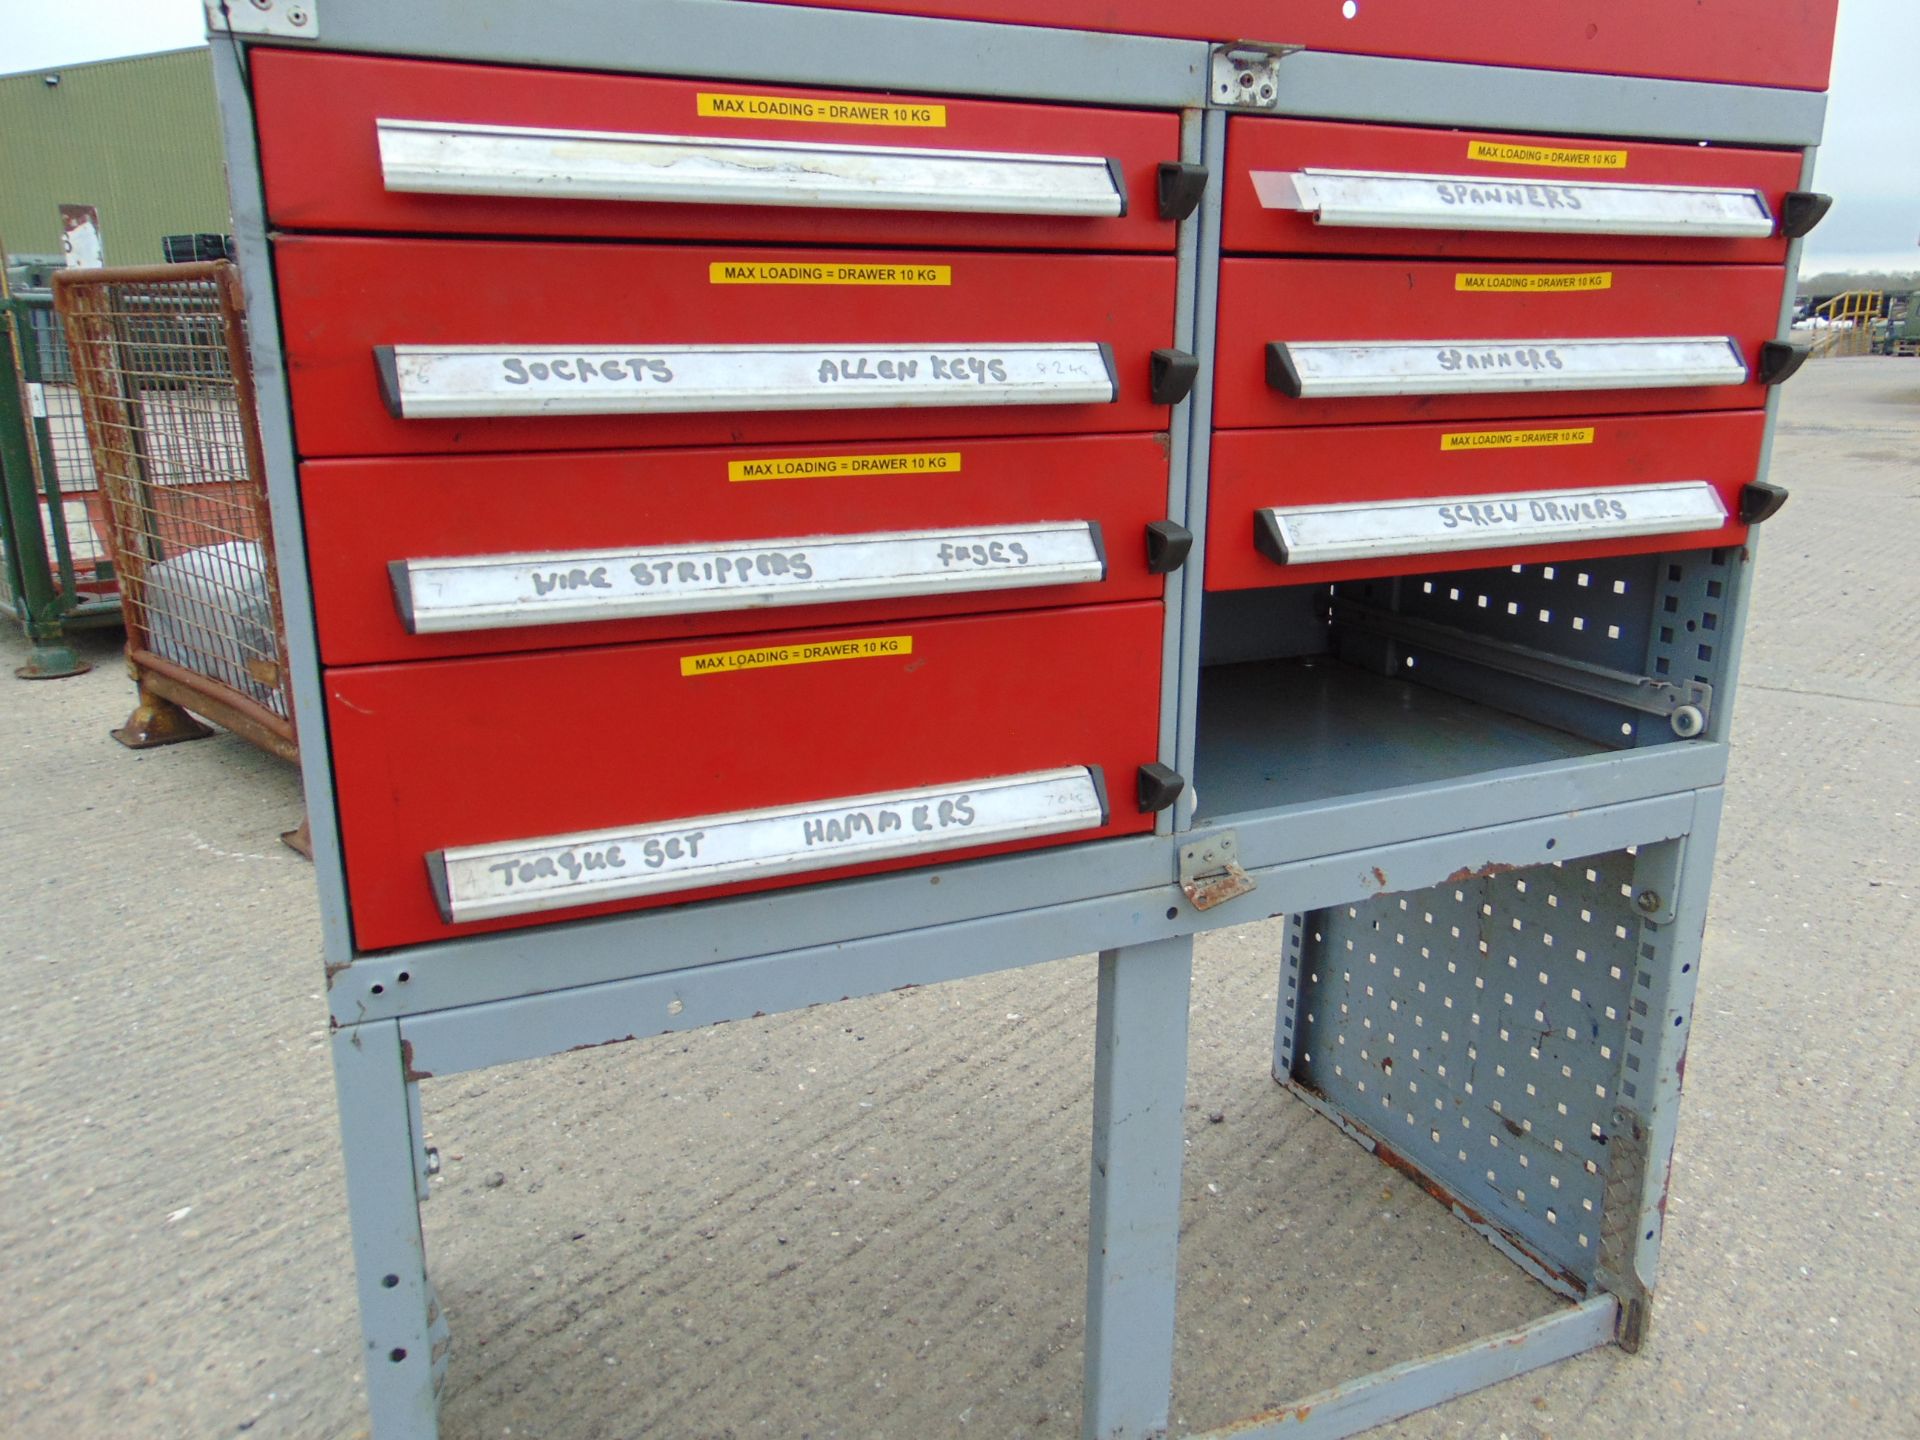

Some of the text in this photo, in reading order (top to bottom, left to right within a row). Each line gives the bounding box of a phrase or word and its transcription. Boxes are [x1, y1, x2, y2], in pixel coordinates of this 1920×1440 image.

[712, 98, 745, 113] MAX
[749, 100, 814, 117] LOADING
[829, 105, 889, 121] DRAWER
[893, 108, 908, 121] 10
[911, 109, 931, 122] KG
[1477, 145, 1499, 158] MAX
[1500, 148, 1543, 162] LOADING
[1551, 152, 1591, 164] DRAWER
[1592, 154, 1602, 164] 10
[1604, 154, 1618, 165] KG
[1436, 183, 1581, 210] SPANNERS
[724, 267, 756, 280] MAX
[759, 267, 823, 280] LOADING
[837, 268, 896, 281] DRAWER
[899, 269, 914, 281] 10
[917, 269, 937, 281] KG
[1465, 277, 1486, 288] MAX
[1487, 277, 1529, 288] LOADING
[1537, 277, 1576, 288] DRAWER
[1578, 276, 1587, 287] 10
[1589, 275, 1603, 286] KG
[502, 357, 673, 385] SOCKETS
[817, 355, 1007, 384] ALLEN KEYS
[1436, 348, 1563, 370] SPANNERS
[1450, 436, 1471, 447] MAX
[1472, 433, 1513, 445] LOADING
[1521, 431, 1559, 443] DRAWER
[1561, 431, 1571, 441] 10
[1571, 431, 1586, 441] KG
[743, 463, 774, 477] MAX
[776, 461, 838, 475] LOADING
[851, 458, 908, 471] DRAWER
[912, 457, 925, 469] 10
[928, 457, 947, 469] KG
[1438, 498, 1627, 528] SCREW DRIVERS
[531, 552, 813, 596] WIRE STRIPPERS
[695, 657, 726, 671] MAX
[728, 650, 789, 667] LOADING
[803, 643, 860, 659] DRAWER
[863, 642, 877, 653] 10
[880, 640, 899, 652] KG
[803, 795, 975, 845] HAMMERS
[643, 832, 704, 868] SET
